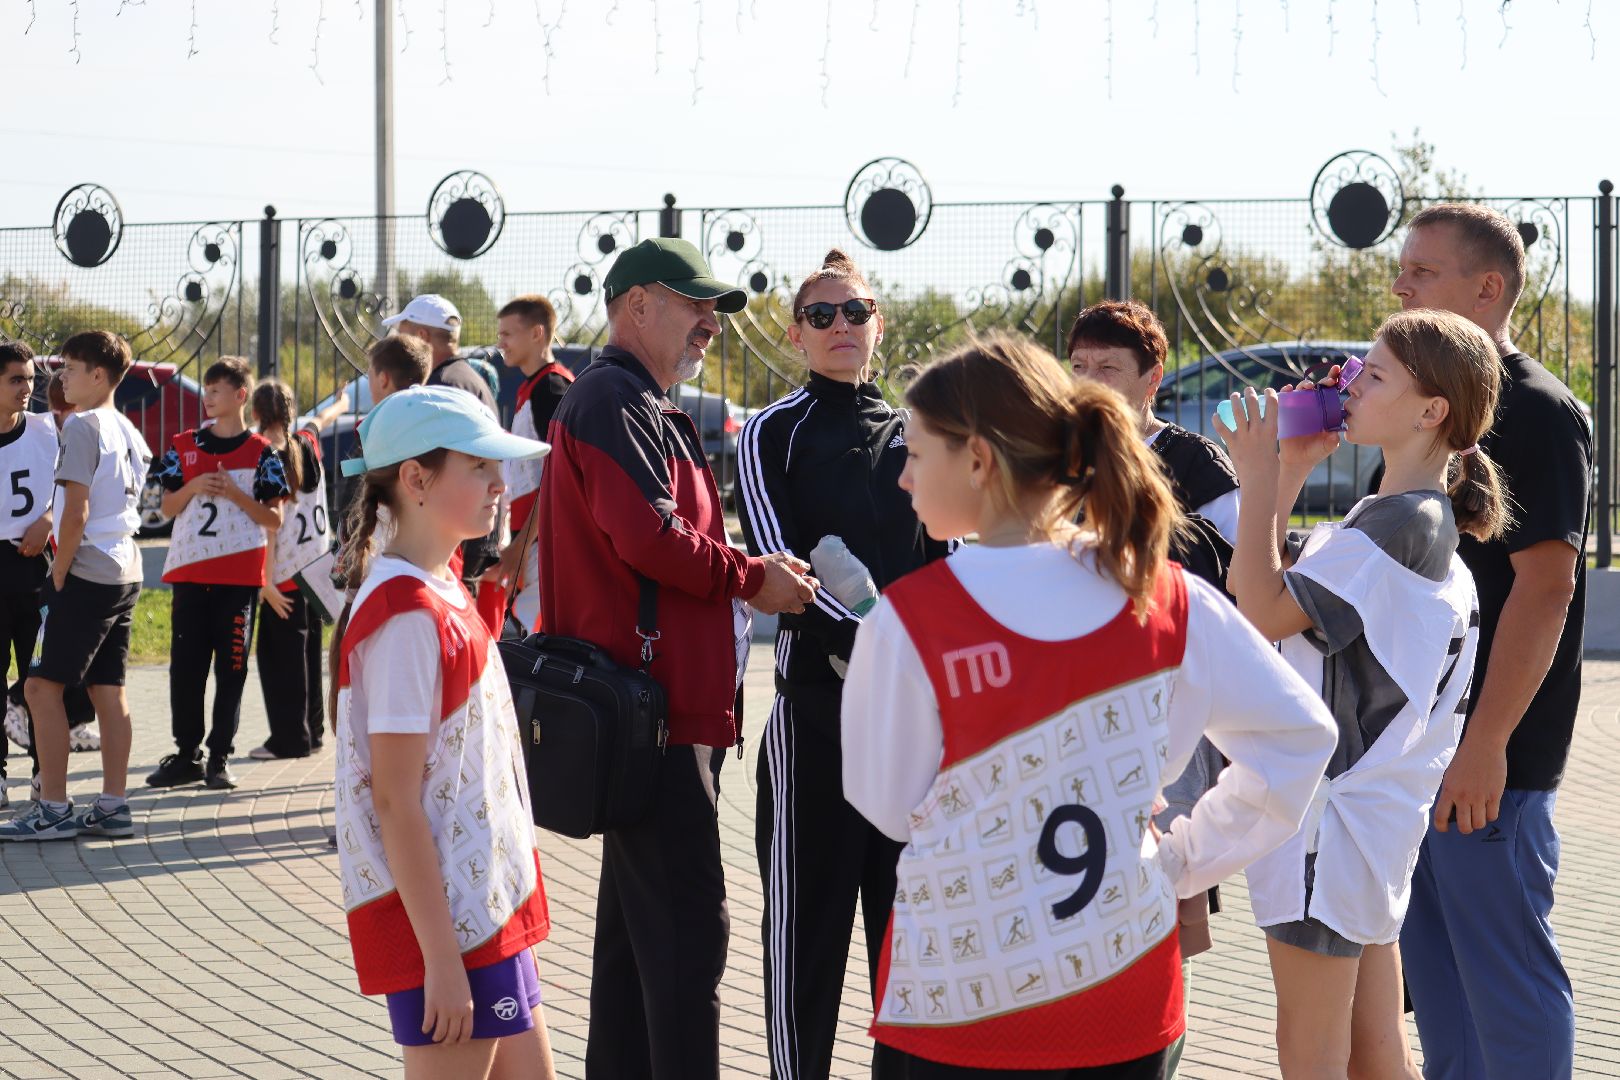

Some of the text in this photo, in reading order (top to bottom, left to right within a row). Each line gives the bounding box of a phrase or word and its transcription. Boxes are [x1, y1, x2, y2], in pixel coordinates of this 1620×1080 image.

[183, 451, 198, 467] ТО
[10, 469, 34, 517] 5
[198, 502, 218, 537] 2
[296, 505, 327, 545] 20
[942, 641, 1012, 698] ГТО
[1037, 804, 1107, 920] 9
